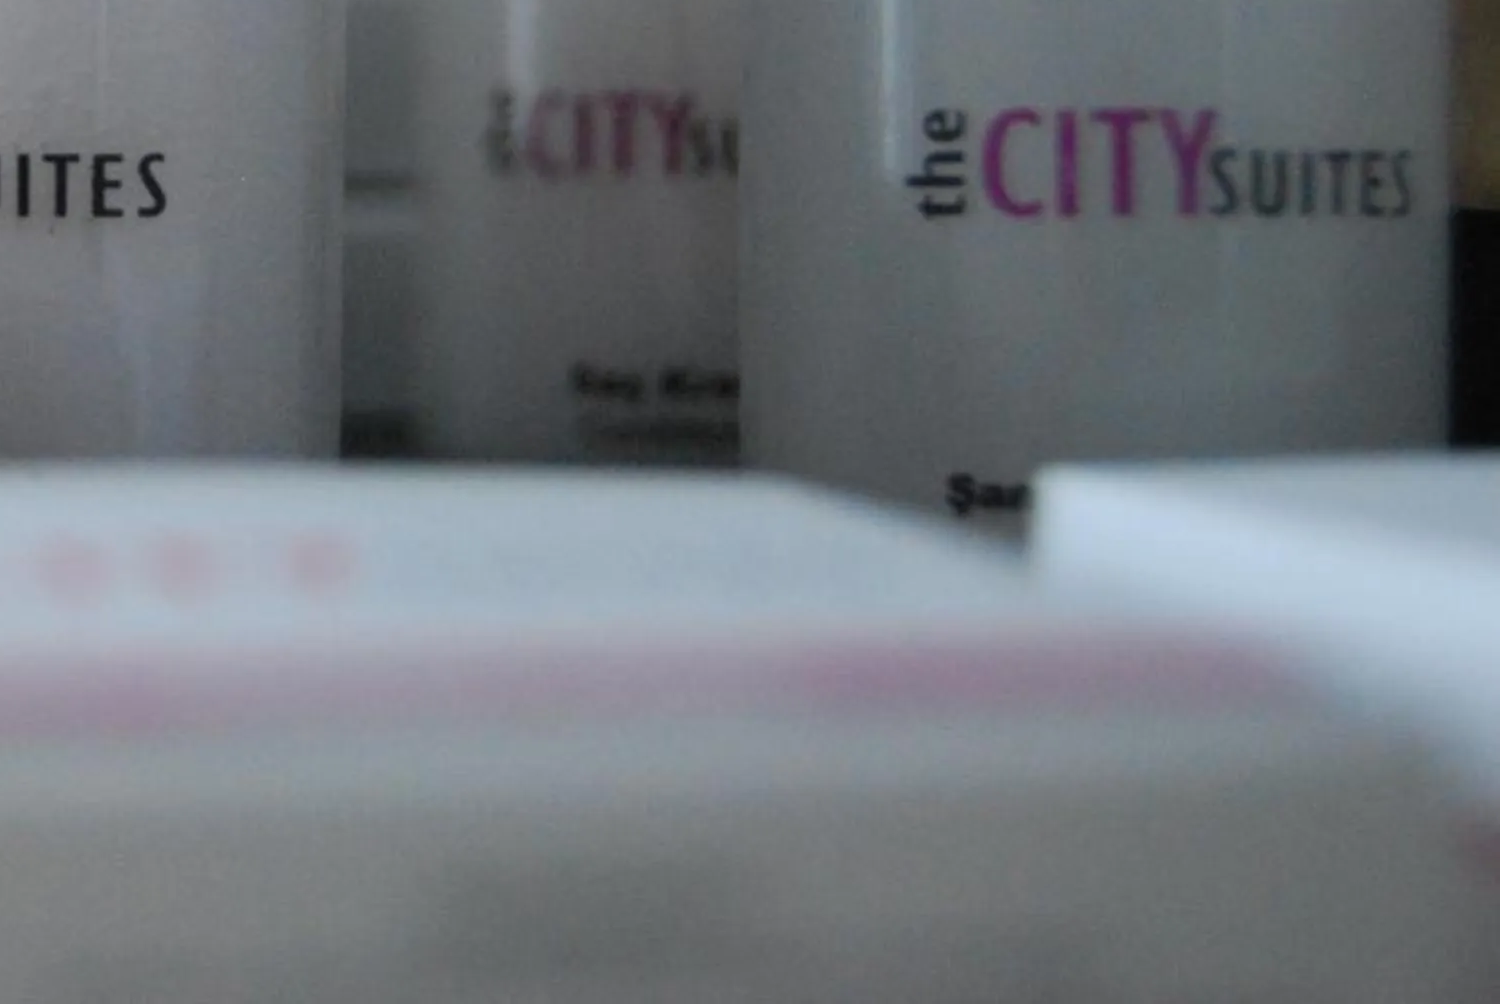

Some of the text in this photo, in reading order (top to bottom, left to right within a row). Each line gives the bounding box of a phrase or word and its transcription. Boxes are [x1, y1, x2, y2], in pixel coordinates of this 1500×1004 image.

[905, 107, 1412, 220] the CITY SUITES
